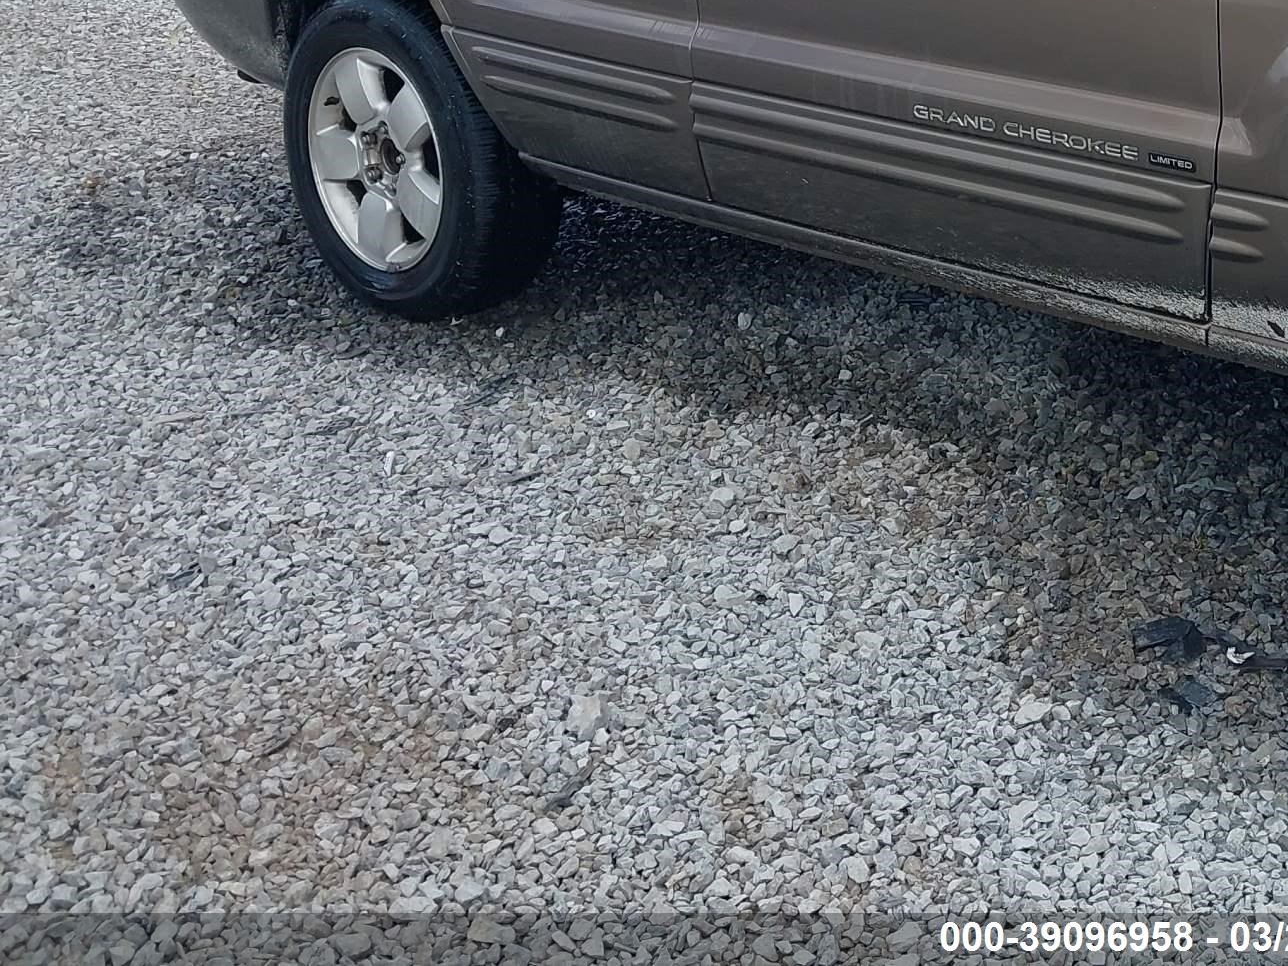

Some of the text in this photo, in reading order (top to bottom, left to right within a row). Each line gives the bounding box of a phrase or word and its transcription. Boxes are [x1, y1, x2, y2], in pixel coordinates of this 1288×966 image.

[913, 104, 1139, 161] GRAND CHEROKEE
[1150, 154, 1194, 170] LIMITED
